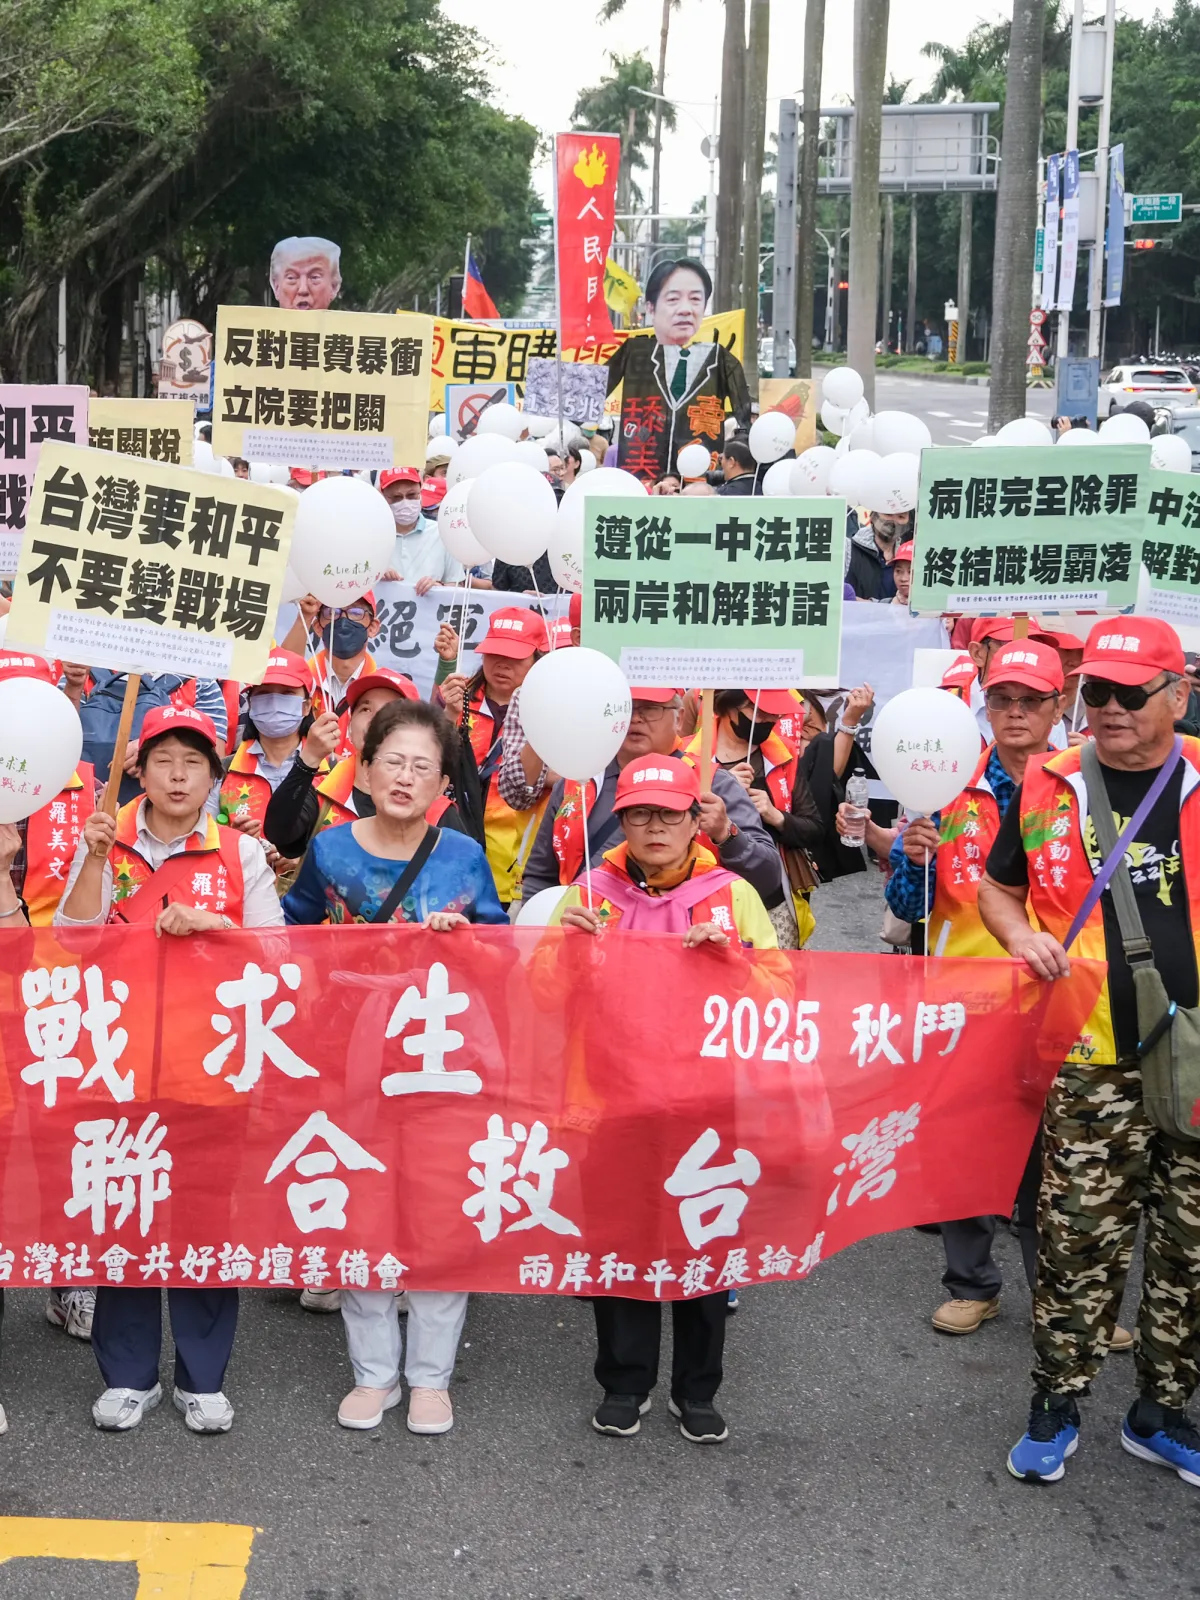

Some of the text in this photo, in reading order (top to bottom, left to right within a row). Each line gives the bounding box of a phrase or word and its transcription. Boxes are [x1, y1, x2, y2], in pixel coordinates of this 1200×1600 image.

[223, 327, 423, 377] 反對軍費暴衝
[221, 384, 386, 432] 立院要把關
[526, 395, 602, 421] 1.25兆
[40, 467, 285, 567] 台灣要和平
[929, 473, 1138, 519] 病假完全除罪
[594, 514, 833, 563] 遵從一中法理
[322, 560, 372, 577] 反Lie求真
[922, 542, 1132, 587] 終結職場霸凌
[27, 540, 271, 641] 不要變戰場
[593, 579, 830, 627] 兩岸和解對話
[493, 619, 524, 632] 勞動黨
[1096, 634, 1141, 653] 勞動黨
[1001, 651, 1038, 667] 勞動黨
[896, 739, 945, 754] 反Lie求真
[910, 759, 960, 773] 反戰求生
[633, 767, 675, 784] 勞動黨
[47, 800, 69, 881] 羅美文
[69, 792, 80, 846] 新竹縣議員
[951, 854, 965, 884] 志工
[962, 820, 983, 884] 勞動黨
[1033, 854, 1049, 888] 志工
[1048, 817, 1072, 889] 勞動黨
[699, 994, 821, 1064] 2025
[519, 1231, 826, 1299] 兩岸和平發展論壇
